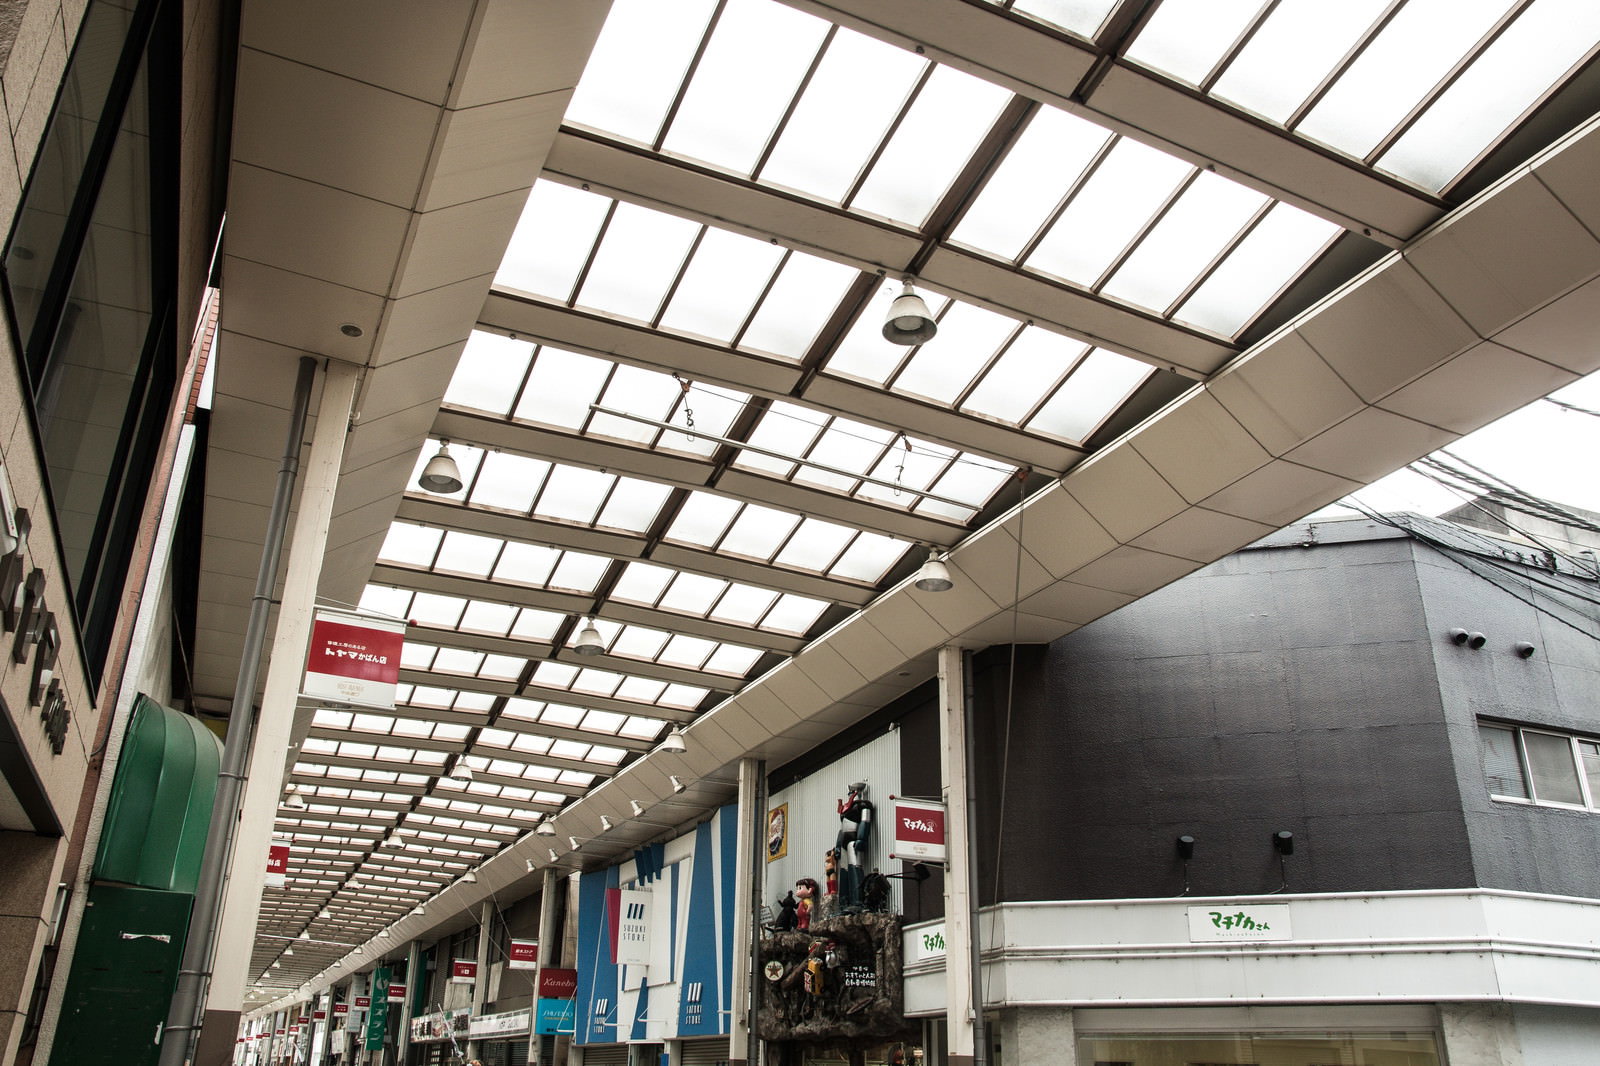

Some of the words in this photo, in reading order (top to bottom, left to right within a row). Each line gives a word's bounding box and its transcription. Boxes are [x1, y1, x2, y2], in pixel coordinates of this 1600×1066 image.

[325, 647, 387, 664] トヤマかばん店
[1208, 911, 1271, 931] マチナカさん
[623, 924, 646, 933] SUZUKI
[623, 933, 646, 942] STORE
[543, 978, 576, 987] Kanebo
[685, 1015, 701, 1025] STORE
